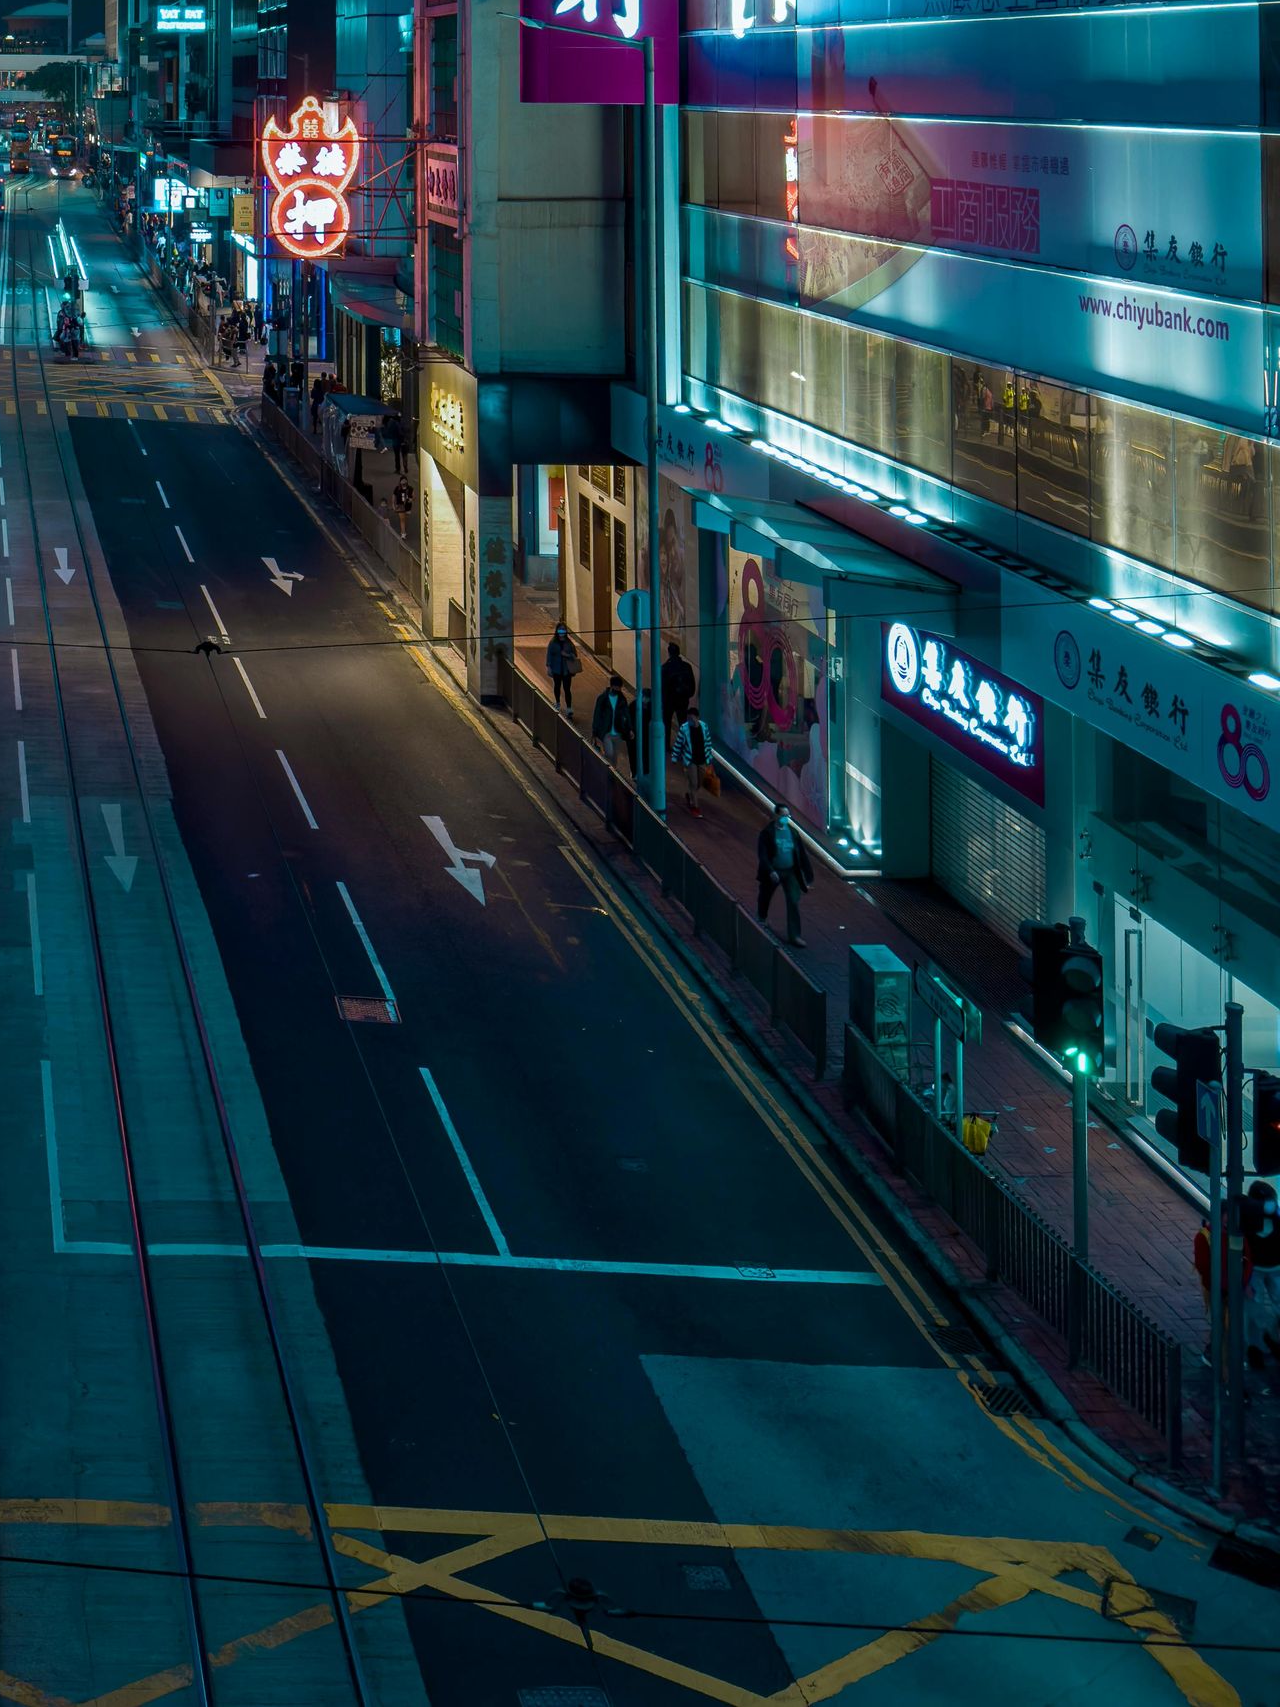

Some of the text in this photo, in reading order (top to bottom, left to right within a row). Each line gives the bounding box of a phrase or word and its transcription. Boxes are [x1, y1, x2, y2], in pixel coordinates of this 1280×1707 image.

[283, 189, 338, 244] 押
[931, 180, 1040, 254] 工商服務
[1143, 229, 1229, 273] 集友銀行
[1078, 295, 1230, 342] www.chiyubank.com
[1087, 646, 1189, 736] 集友銀行
